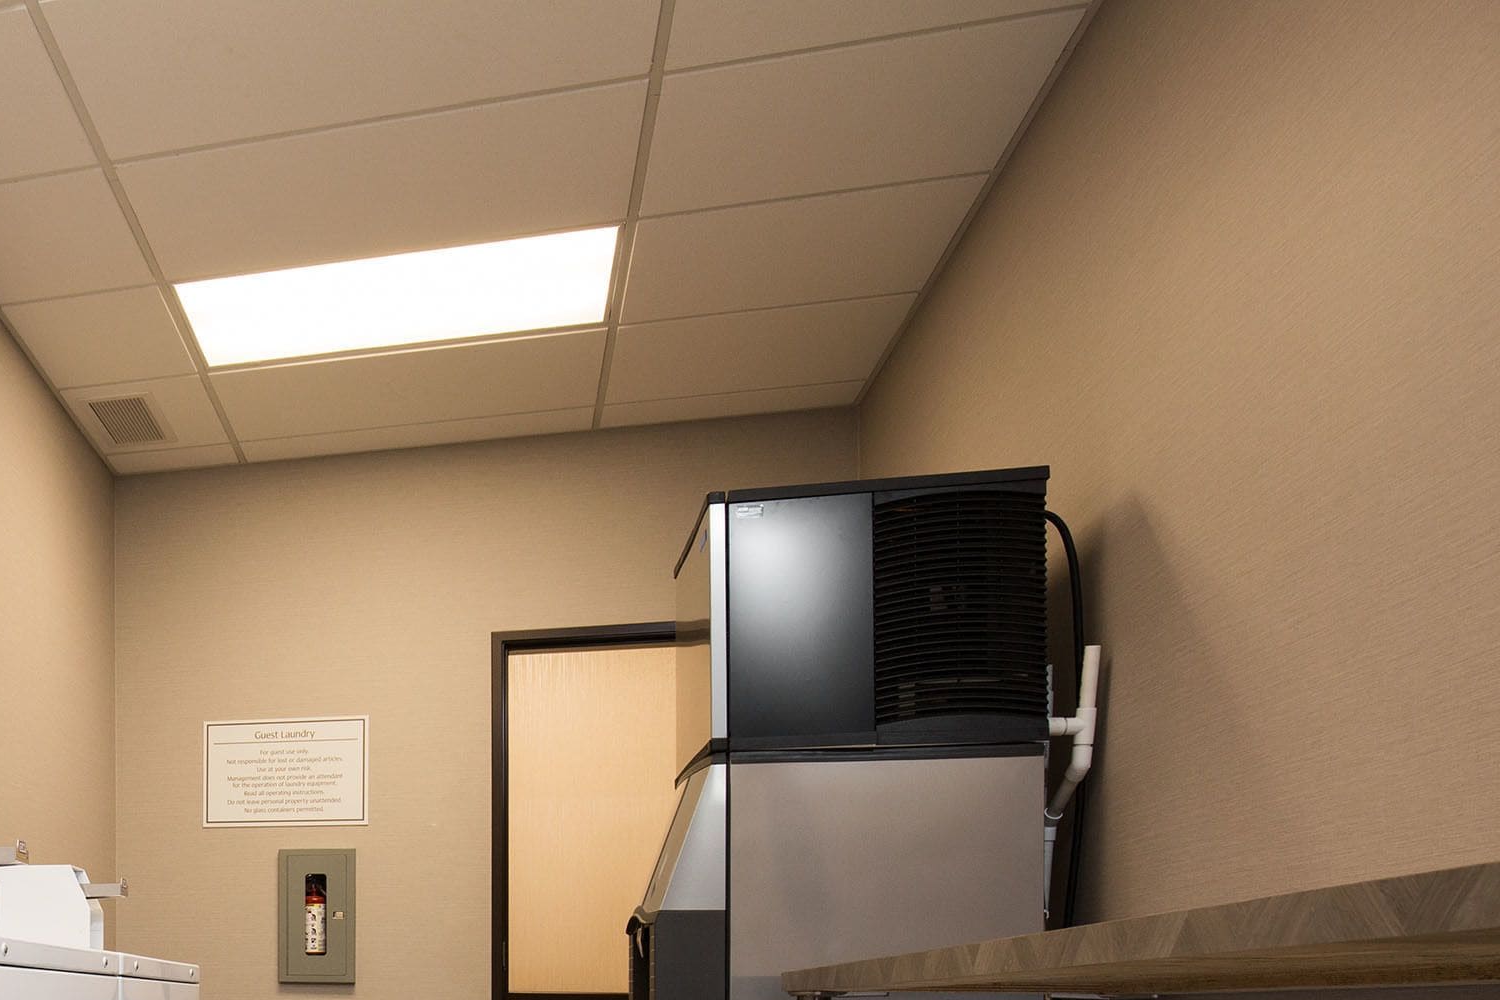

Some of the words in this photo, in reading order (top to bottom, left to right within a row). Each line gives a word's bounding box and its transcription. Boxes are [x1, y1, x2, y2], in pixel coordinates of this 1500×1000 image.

[254, 730, 278, 740] Guest
[280, 729, 316, 740] Laundry
[237, 757, 267, 766] responsible
[265, 789, 291, 797] operating
[285, 798, 308, 806] property
